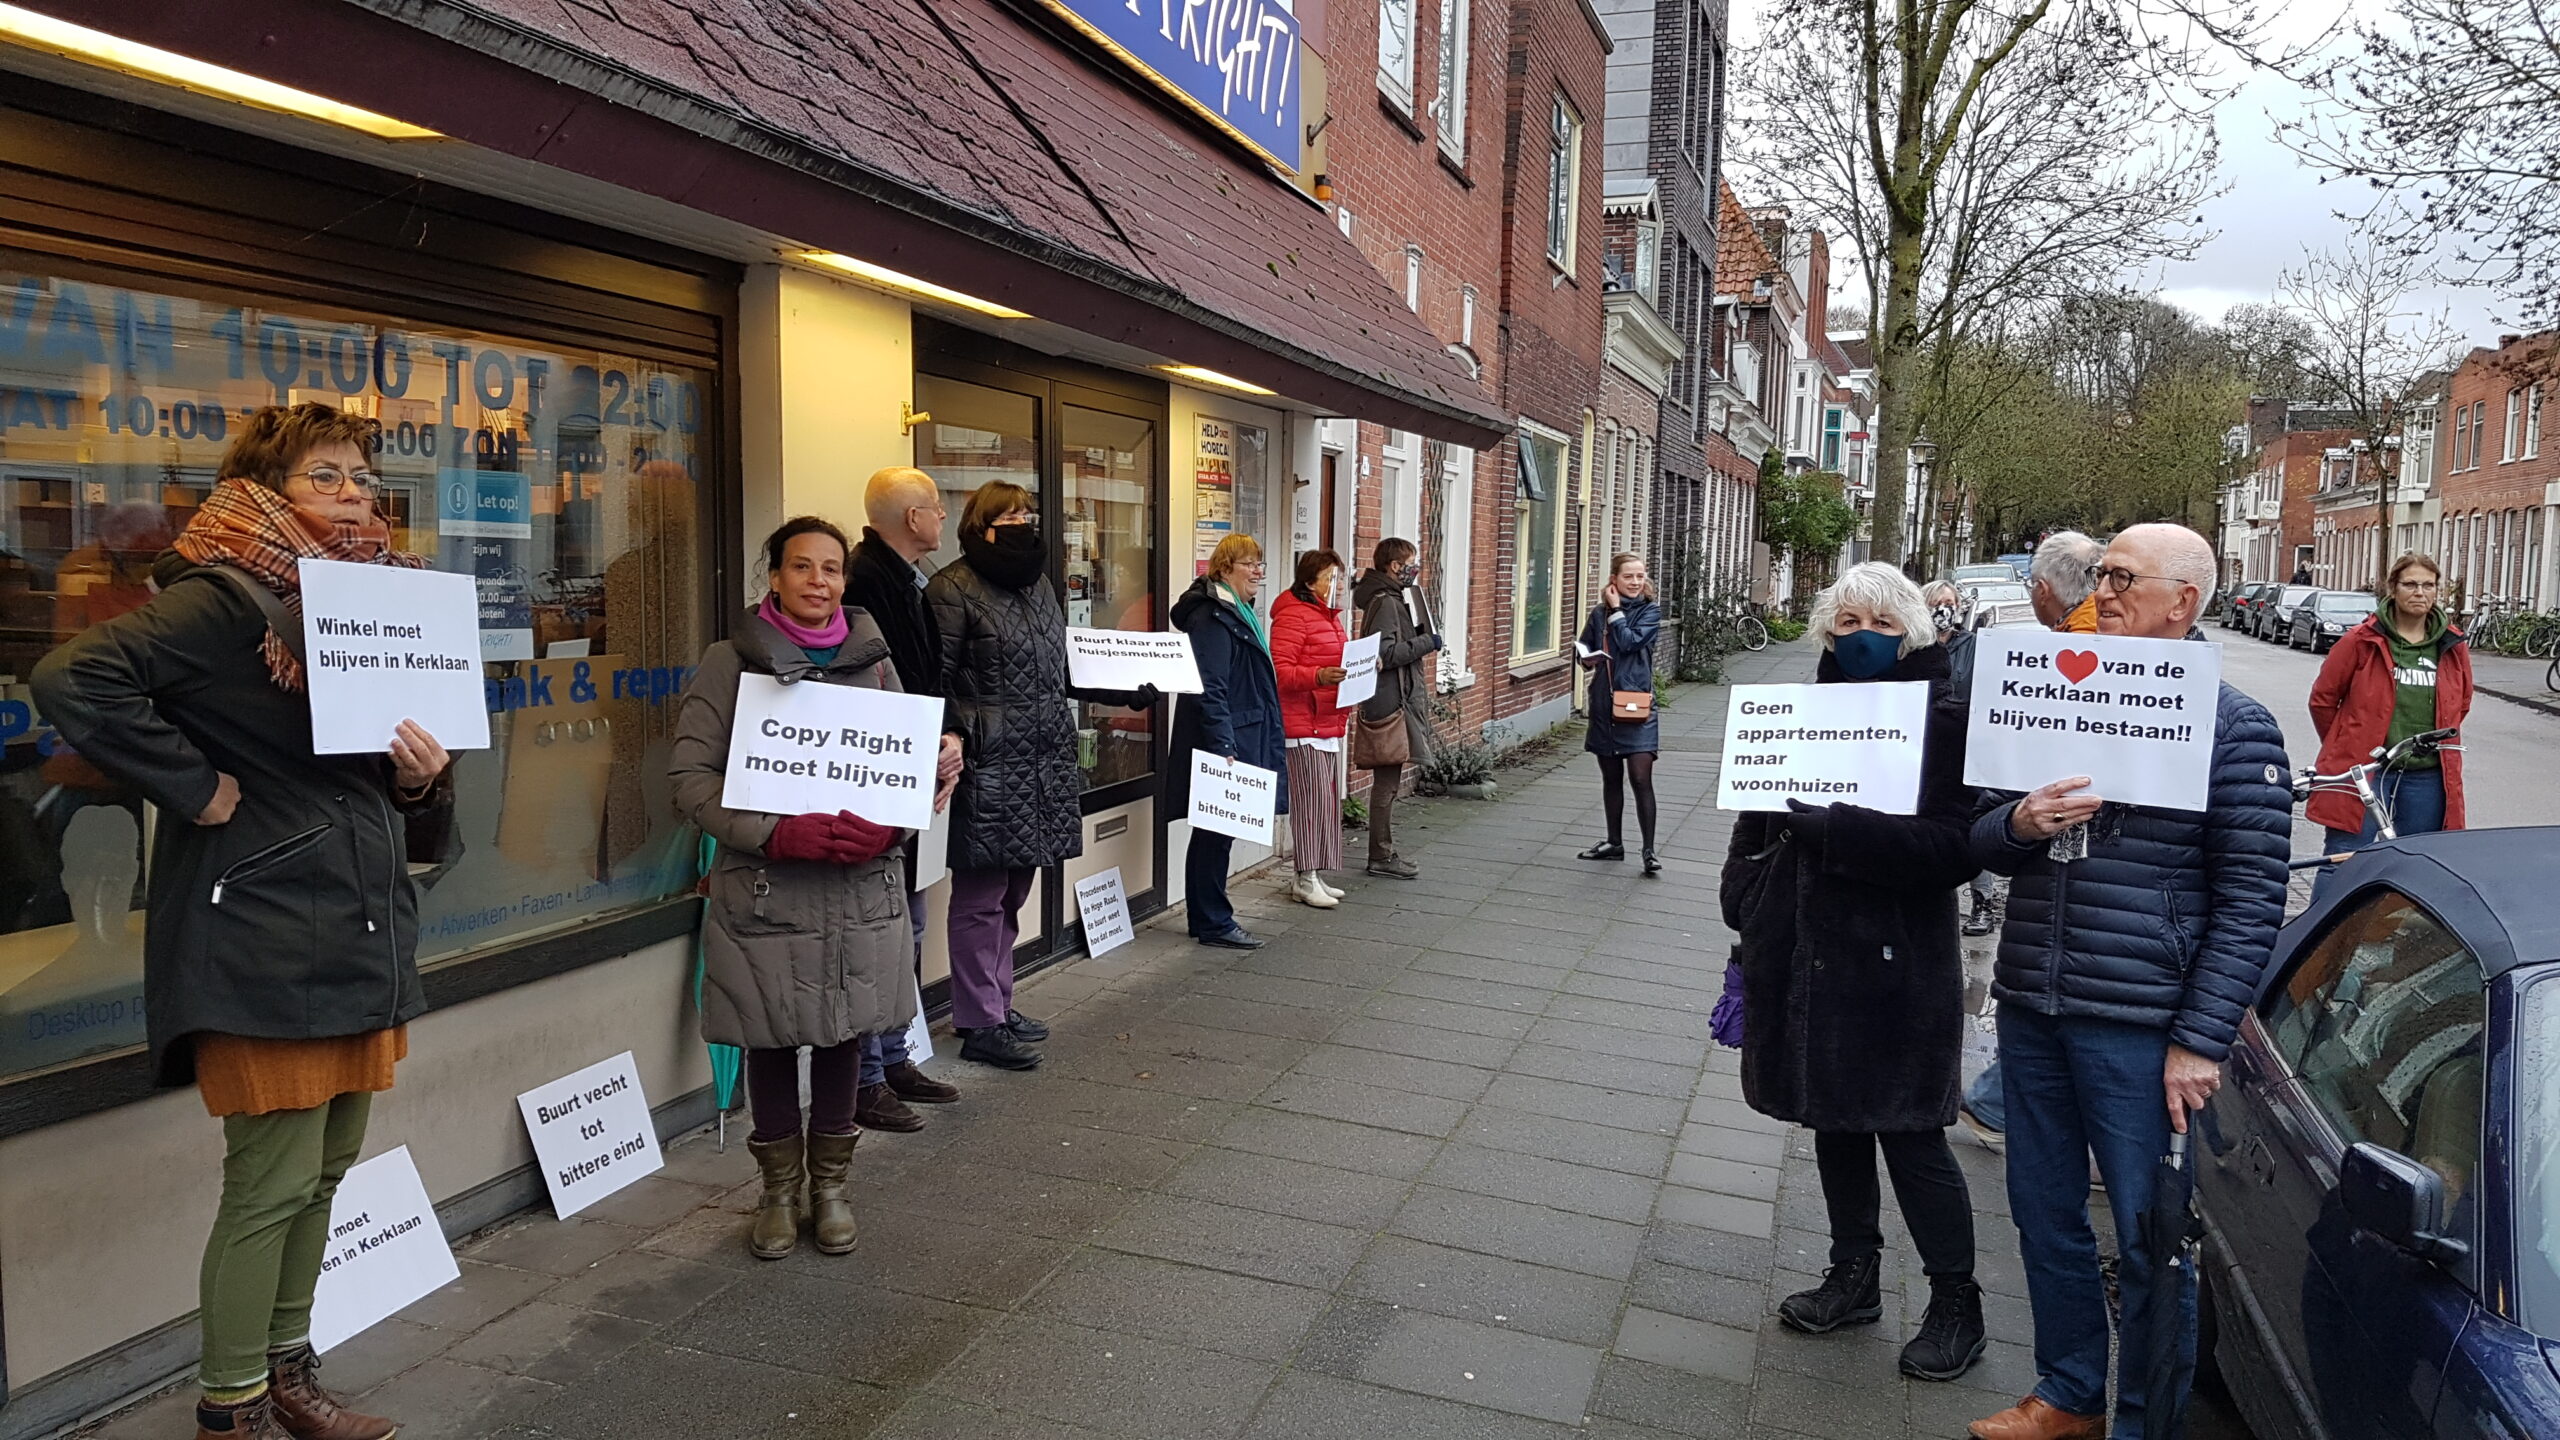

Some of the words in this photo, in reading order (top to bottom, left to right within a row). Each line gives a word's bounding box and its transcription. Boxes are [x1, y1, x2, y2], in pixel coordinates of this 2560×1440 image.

[1125, 0, 1294, 127] RIGHT!
[211, 308, 413, 400] 10:00
[432, 342, 548, 422] TOT
[0, 386, 78, 435] AT
[99, 393, 226, 442] 10:00
[1201, 423, 1219, 438] HELP
[477, 492, 497, 509] Let
[499, 495, 519, 512] op!
[472, 544, 488, 557] zijn
[489, 545, 502, 557] wij
[501, 595, 515, 603] uur
[316, 617, 378, 638] Winkel
[383, 623, 422, 639] moet
[1073, 635, 1113, 645] Buurt
[1116, 638, 1151, 647] klaar
[1078, 647, 1184, 658] huisjesmelkers
[319, 650, 380, 672] blijven
[384, 652, 400, 669] in
[404, 653, 470, 671] Kerklaan
[2006, 651, 2049, 669] Het
[2102, 660, 2145, 676] van
[2154, 661, 2185, 678] de
[570, 661, 597, 703] &
[612, 663, 696, 705] repr
[2001, 680, 2111, 704] Kerklaan
[2119, 692, 2184, 710] moet
[1740, 701, 1793, 715] Geen
[761, 718, 831, 748] Copy
[840, 728, 912, 755] Right
[1737, 726, 1908, 743] appartementen,
[1988, 709, 2067, 730] blijven
[2075, 716, 2192, 742] bestaan!!
[745, 754, 818, 777] moet
[827, 761, 917, 789] blijven
[1734, 754, 1788, 765] maar
[1200, 762, 1232, 781] Buurt
[1235, 774, 1267, 791] vecht
[1731, 778, 1858, 793] woonhuizen
[1225, 789, 1241, 802] tot
[1198, 800, 1237, 820] bittere
[1240, 813, 1264, 828] eind
[1080, 883, 1107, 900] Procederen
[1108, 879, 1116, 888] tot
[521, 890, 563, 917] Faxen
[1083, 906, 1090, 915] de
[1091, 901, 1103, 913] Hoge
[1104, 893, 1119, 906] Raad,
[1087, 921, 1094, 931] de
[1094, 914, 1107, 928] buurt
[1107, 909, 1121, 921] weet
[1090, 935, 1100, 946] hoe
[1100, 931, 1108, 940] dat
[1108, 924, 1123, 937] moet.
[28, 998, 124, 1041] Desktop
[537, 1093, 582, 1125] Buurt
[584, 1074, 628, 1105] vecht
[580, 1117, 605, 1141] tot
[558, 1153, 610, 1188] bittere
[613, 1132, 646, 1161] eind
[333, 1211, 371, 1238] moet
[318, 1255, 342, 1275] en
[342, 1248, 357, 1262] in
[358, 1215, 422, 1253] Kerklaan
